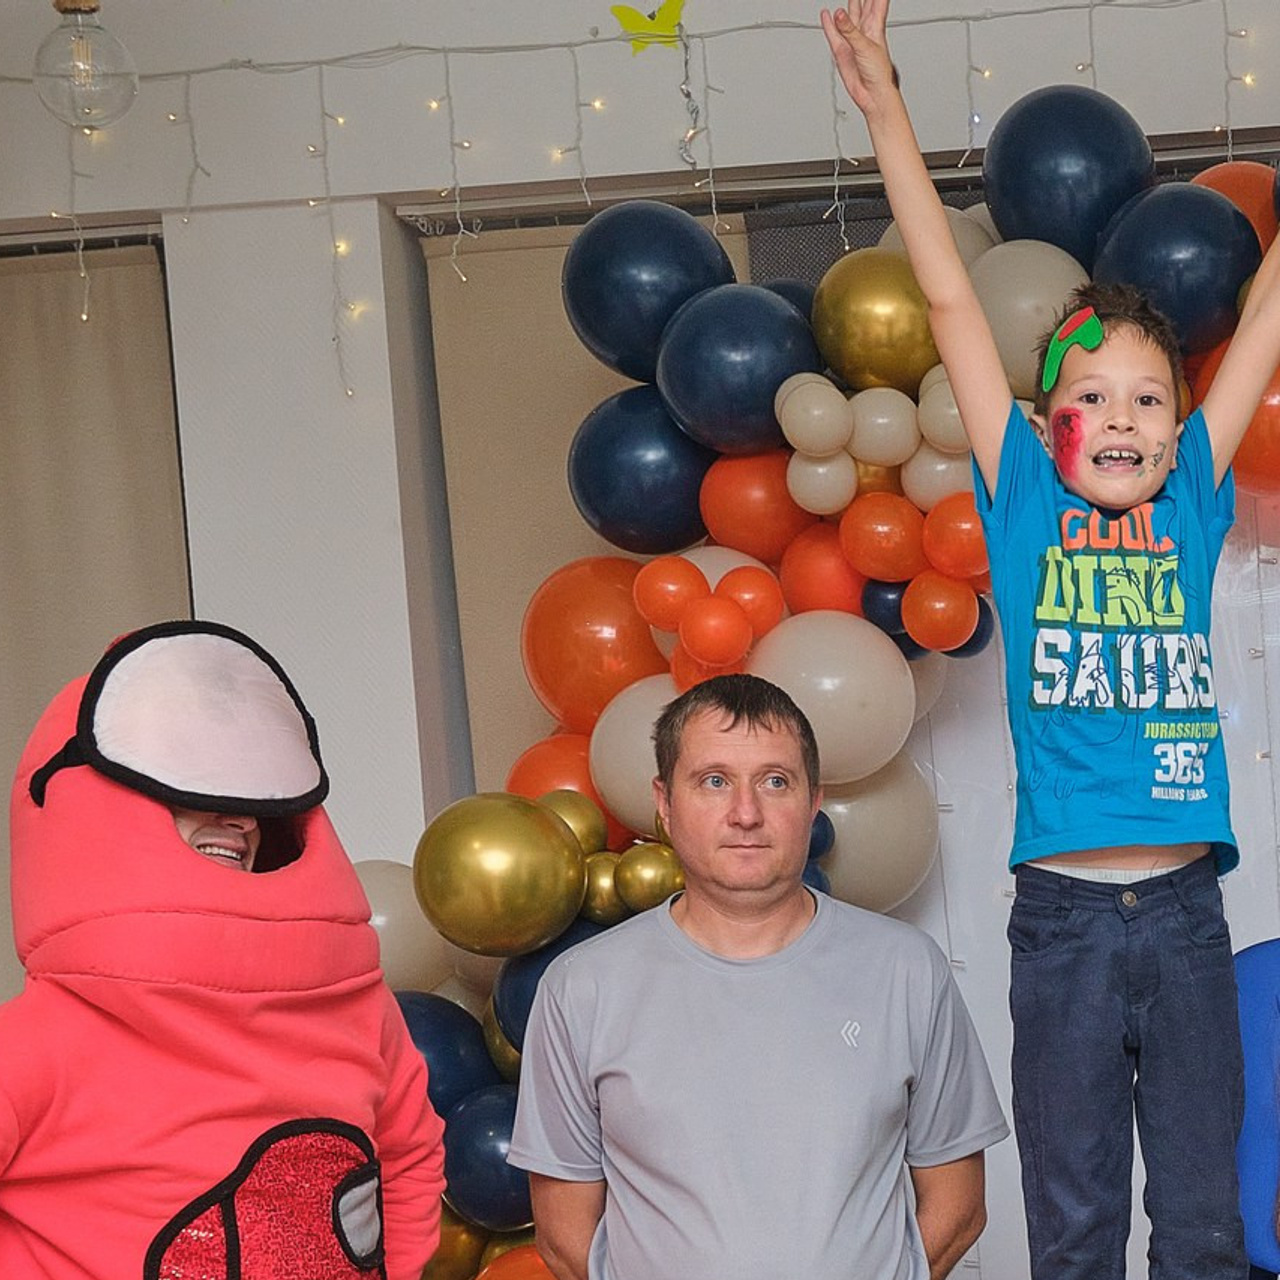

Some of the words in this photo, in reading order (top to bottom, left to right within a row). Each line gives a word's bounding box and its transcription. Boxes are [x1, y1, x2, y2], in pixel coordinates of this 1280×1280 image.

[1061, 502, 1175, 552] COOL
[1035, 546, 1185, 626] DINO
[1033, 628, 1215, 708] SAURS
[1153, 742, 1209, 784] 365
